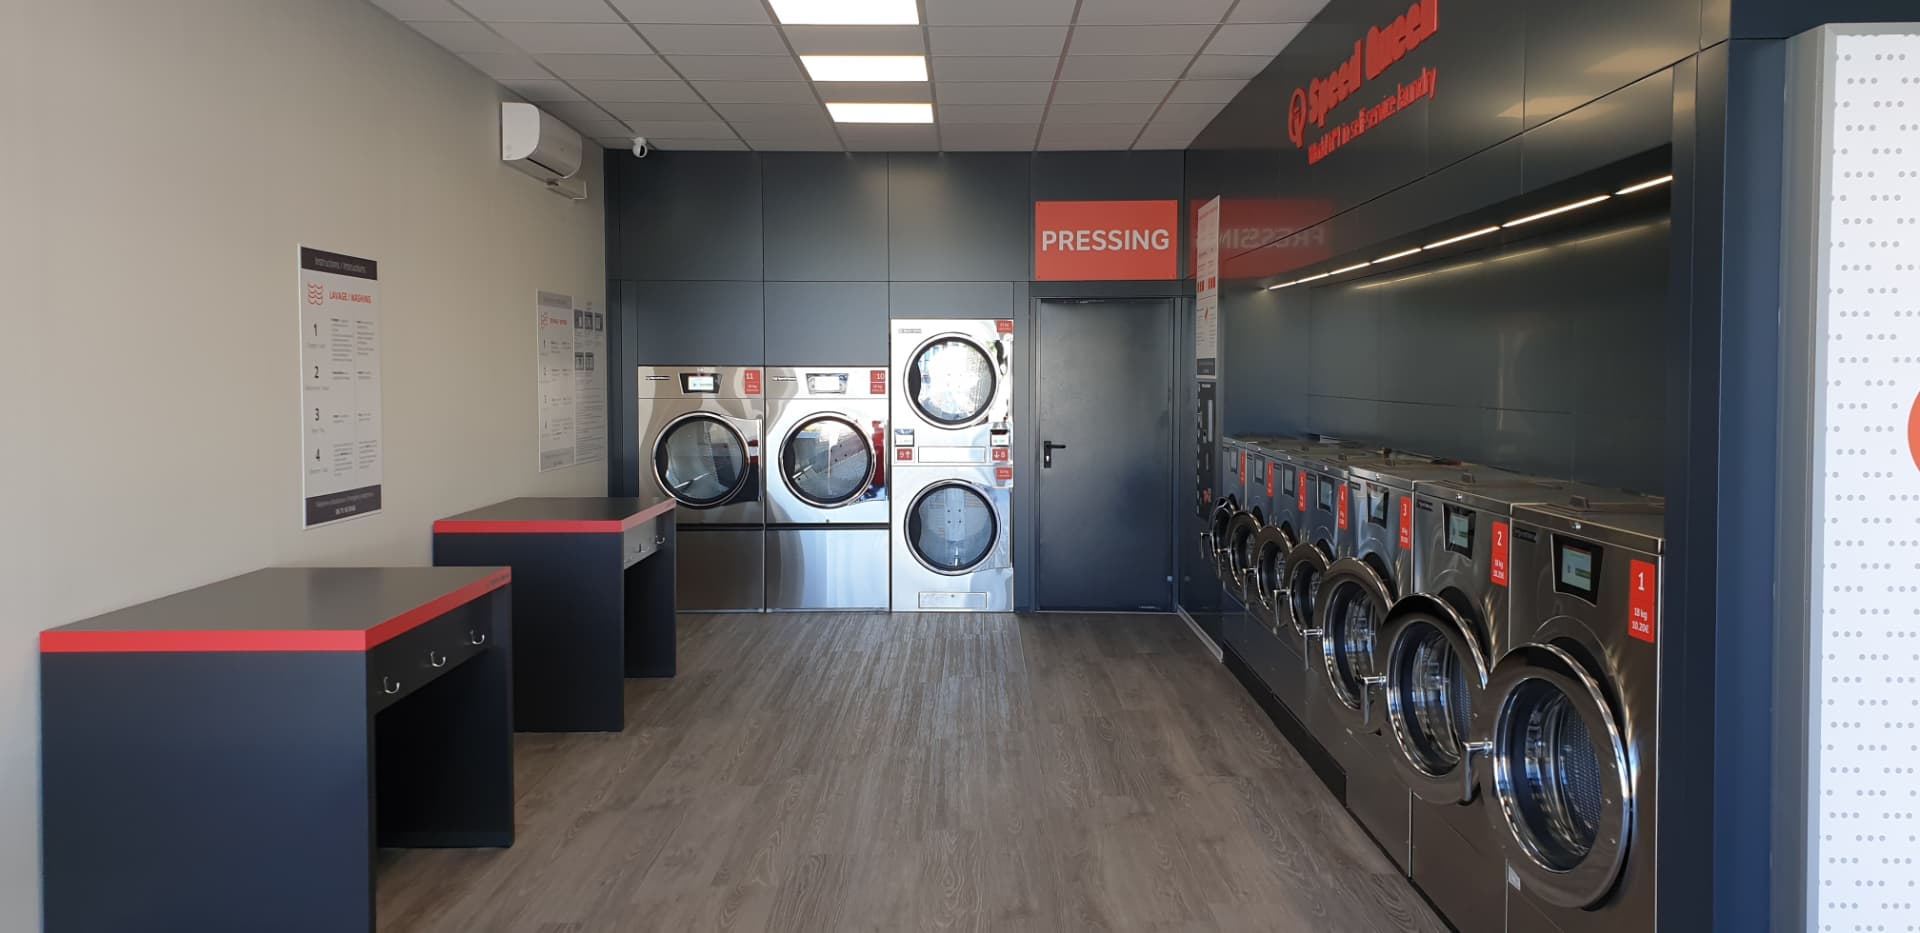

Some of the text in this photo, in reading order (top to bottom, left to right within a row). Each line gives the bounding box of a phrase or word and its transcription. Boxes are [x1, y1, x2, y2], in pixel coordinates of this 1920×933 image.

[1308, 0, 1439, 129] Speed Queen
[1396, 67, 1437, 111] laundry
[1041, 228, 1170, 252] PRESSING
[313, 323, 318, 337] 1
[314, 365, 319, 379] 2
[746, 372, 753, 380] 11
[876, 372, 885, 380] 10
[315, 407, 320, 421] 3
[1497, 530, 1502, 546] 2
[1637, 571, 1645, 592] 1
